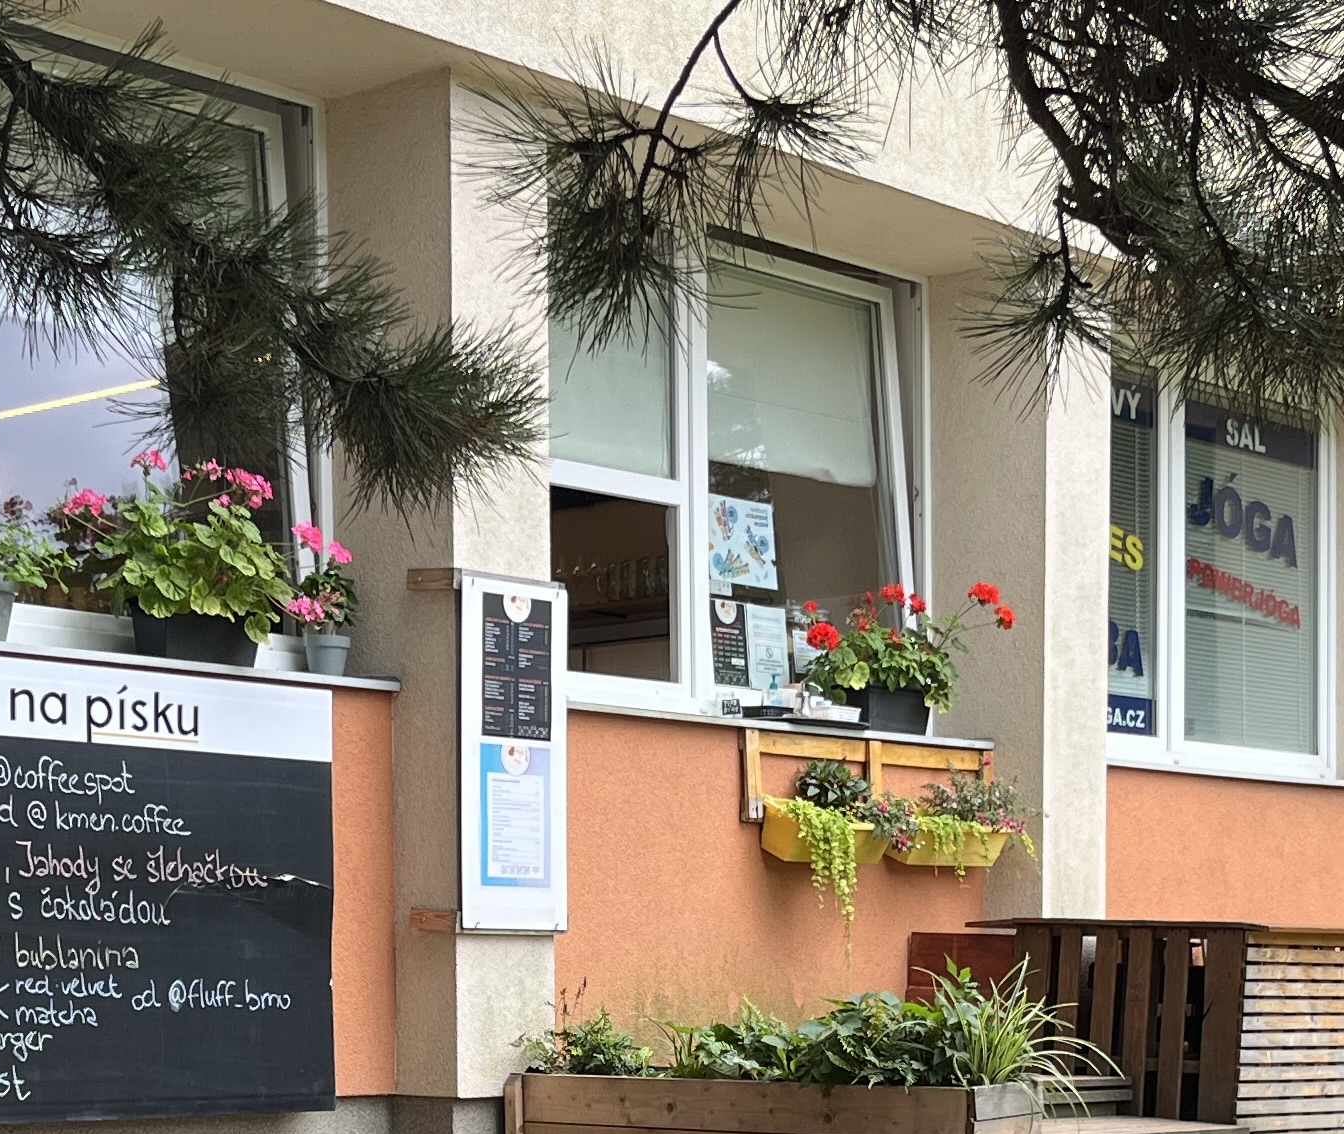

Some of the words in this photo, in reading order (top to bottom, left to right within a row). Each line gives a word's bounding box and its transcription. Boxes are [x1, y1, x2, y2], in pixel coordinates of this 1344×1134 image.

[1225, 416, 1267, 454] SÁL
[1188, 472, 1298, 570] JÓGA
[1188, 556, 1301, 630] POWERJÓGA
[9, 687, 68, 725] na
[86, 684, 199, 743] písku
[15, 840, 101, 894] Jahody
[111, 854, 137, 882] se
[40, 886, 171, 926] čokoládou
[14, 931, 139, 971] bublanina
[15, 975, 53, 996] red
[61, 973, 123, 998] velvet
[131, 980, 161, 1011] od
[15, 1000, 99, 1027] matcha
